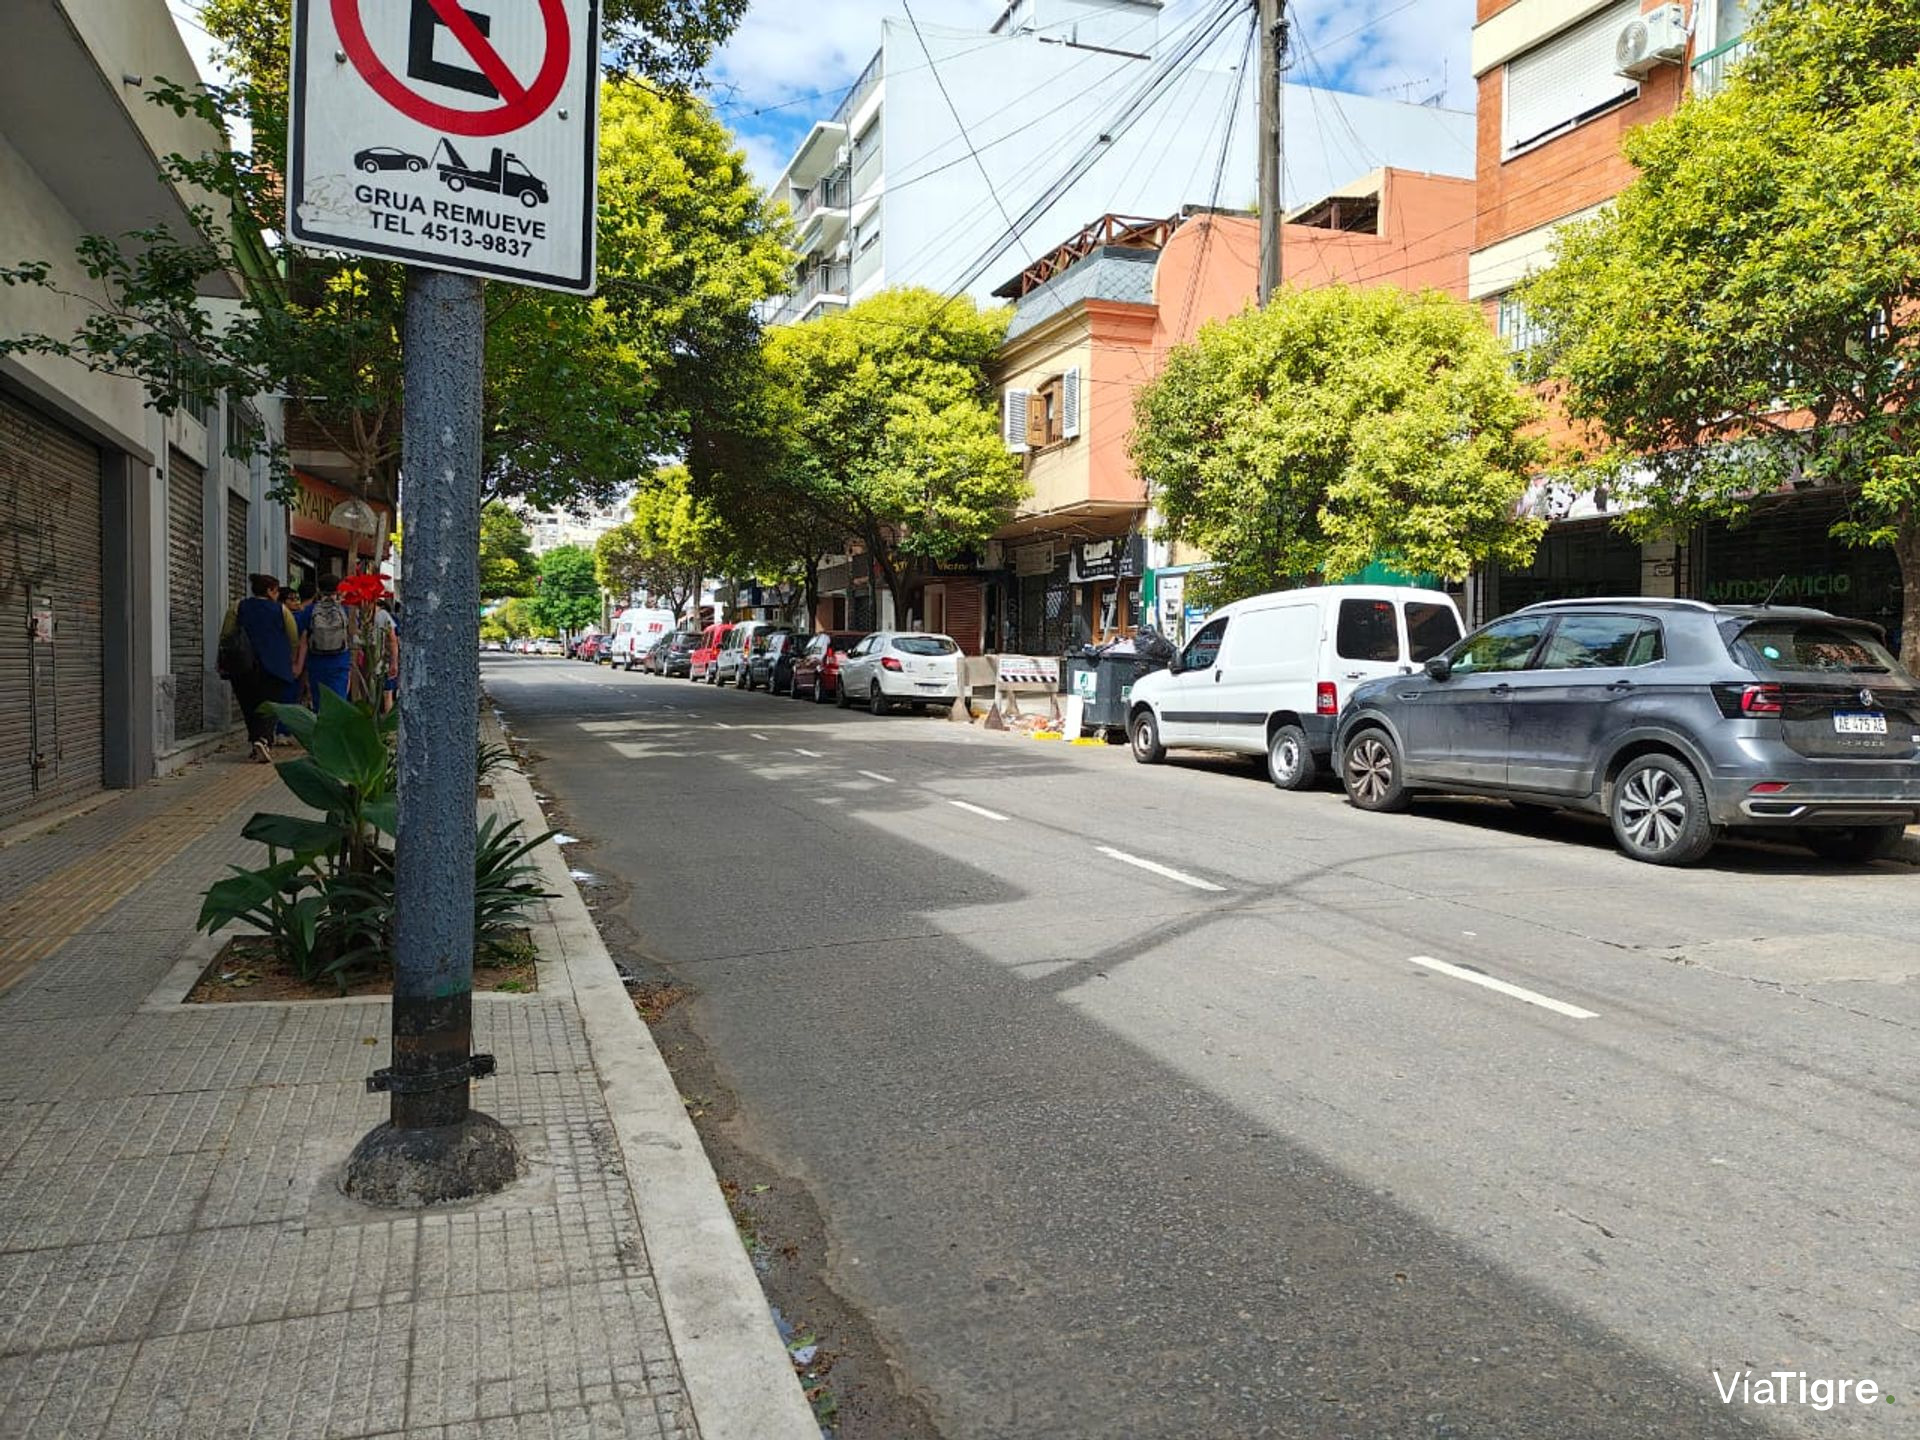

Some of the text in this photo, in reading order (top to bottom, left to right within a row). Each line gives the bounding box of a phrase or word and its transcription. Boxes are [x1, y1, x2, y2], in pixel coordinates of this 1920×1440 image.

[354, 184, 427, 215] GRUA
[433, 199, 547, 240] REMUEVE
[369, 210, 533, 259] TEL 4513-9837
